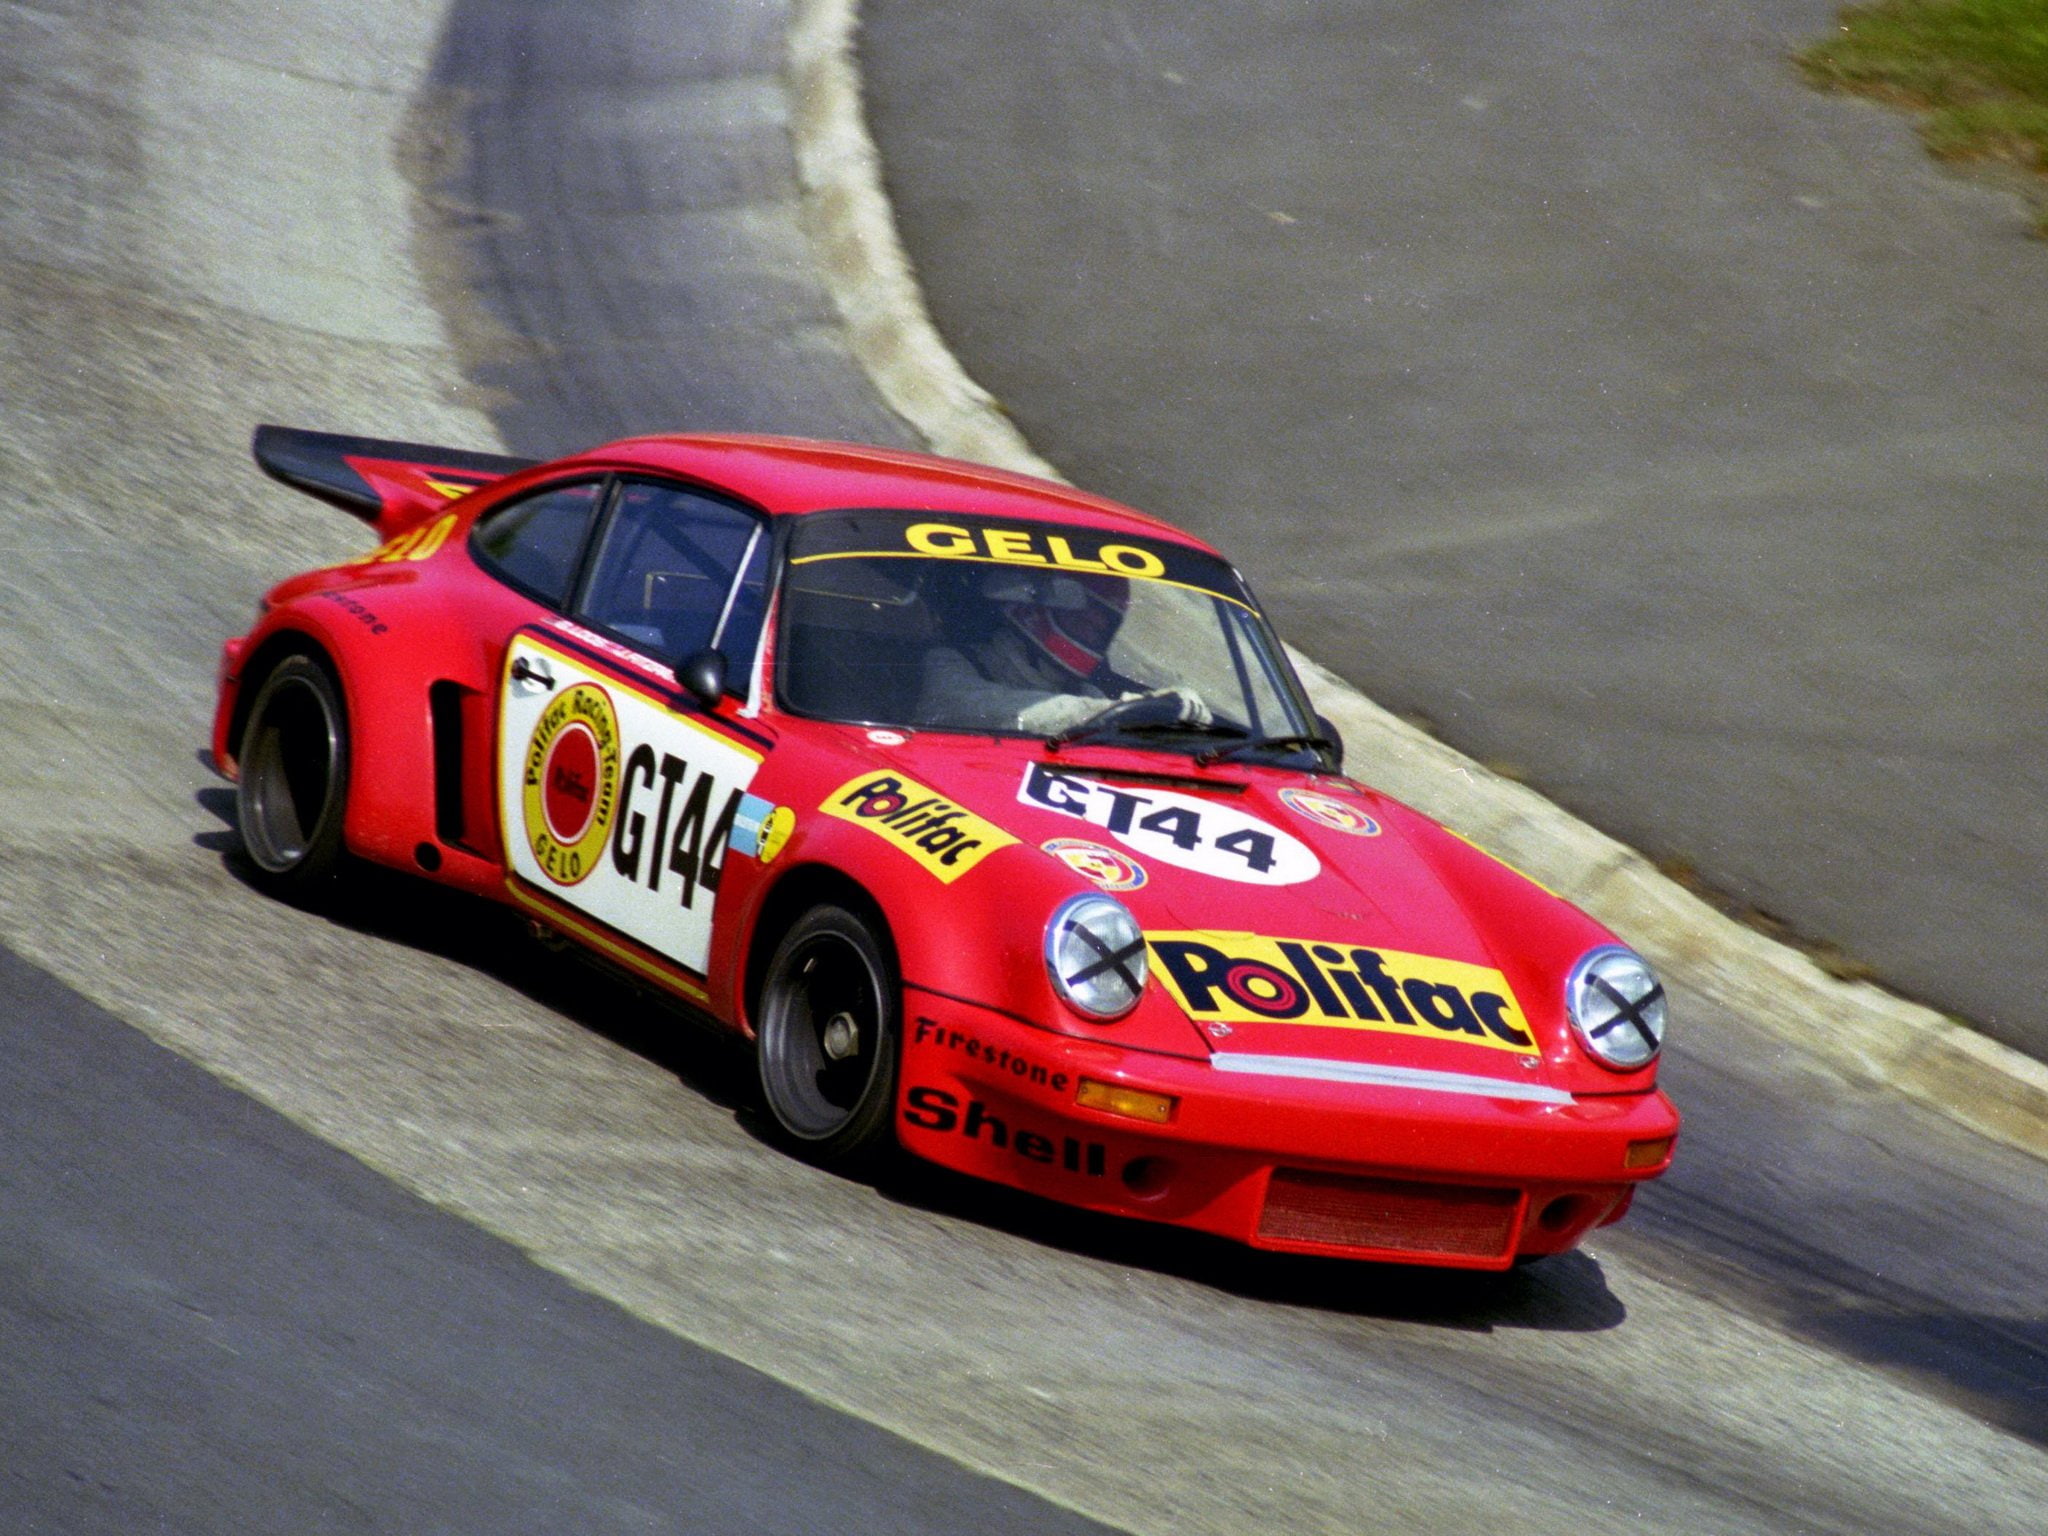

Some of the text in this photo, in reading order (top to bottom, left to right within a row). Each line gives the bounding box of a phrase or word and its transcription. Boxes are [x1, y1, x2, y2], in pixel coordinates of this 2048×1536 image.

[905, 523, 1165, 577] GELO
[536, 833, 581, 879] GELO
[840, 777, 982, 866] Polifac
[1026, 764, 1277, 875] GT44
[1147, 940, 1533, 1047] Polifac
[915, 1016, 1068, 1092] Firestone
[904, 1086, 1105, 1176] Shell
